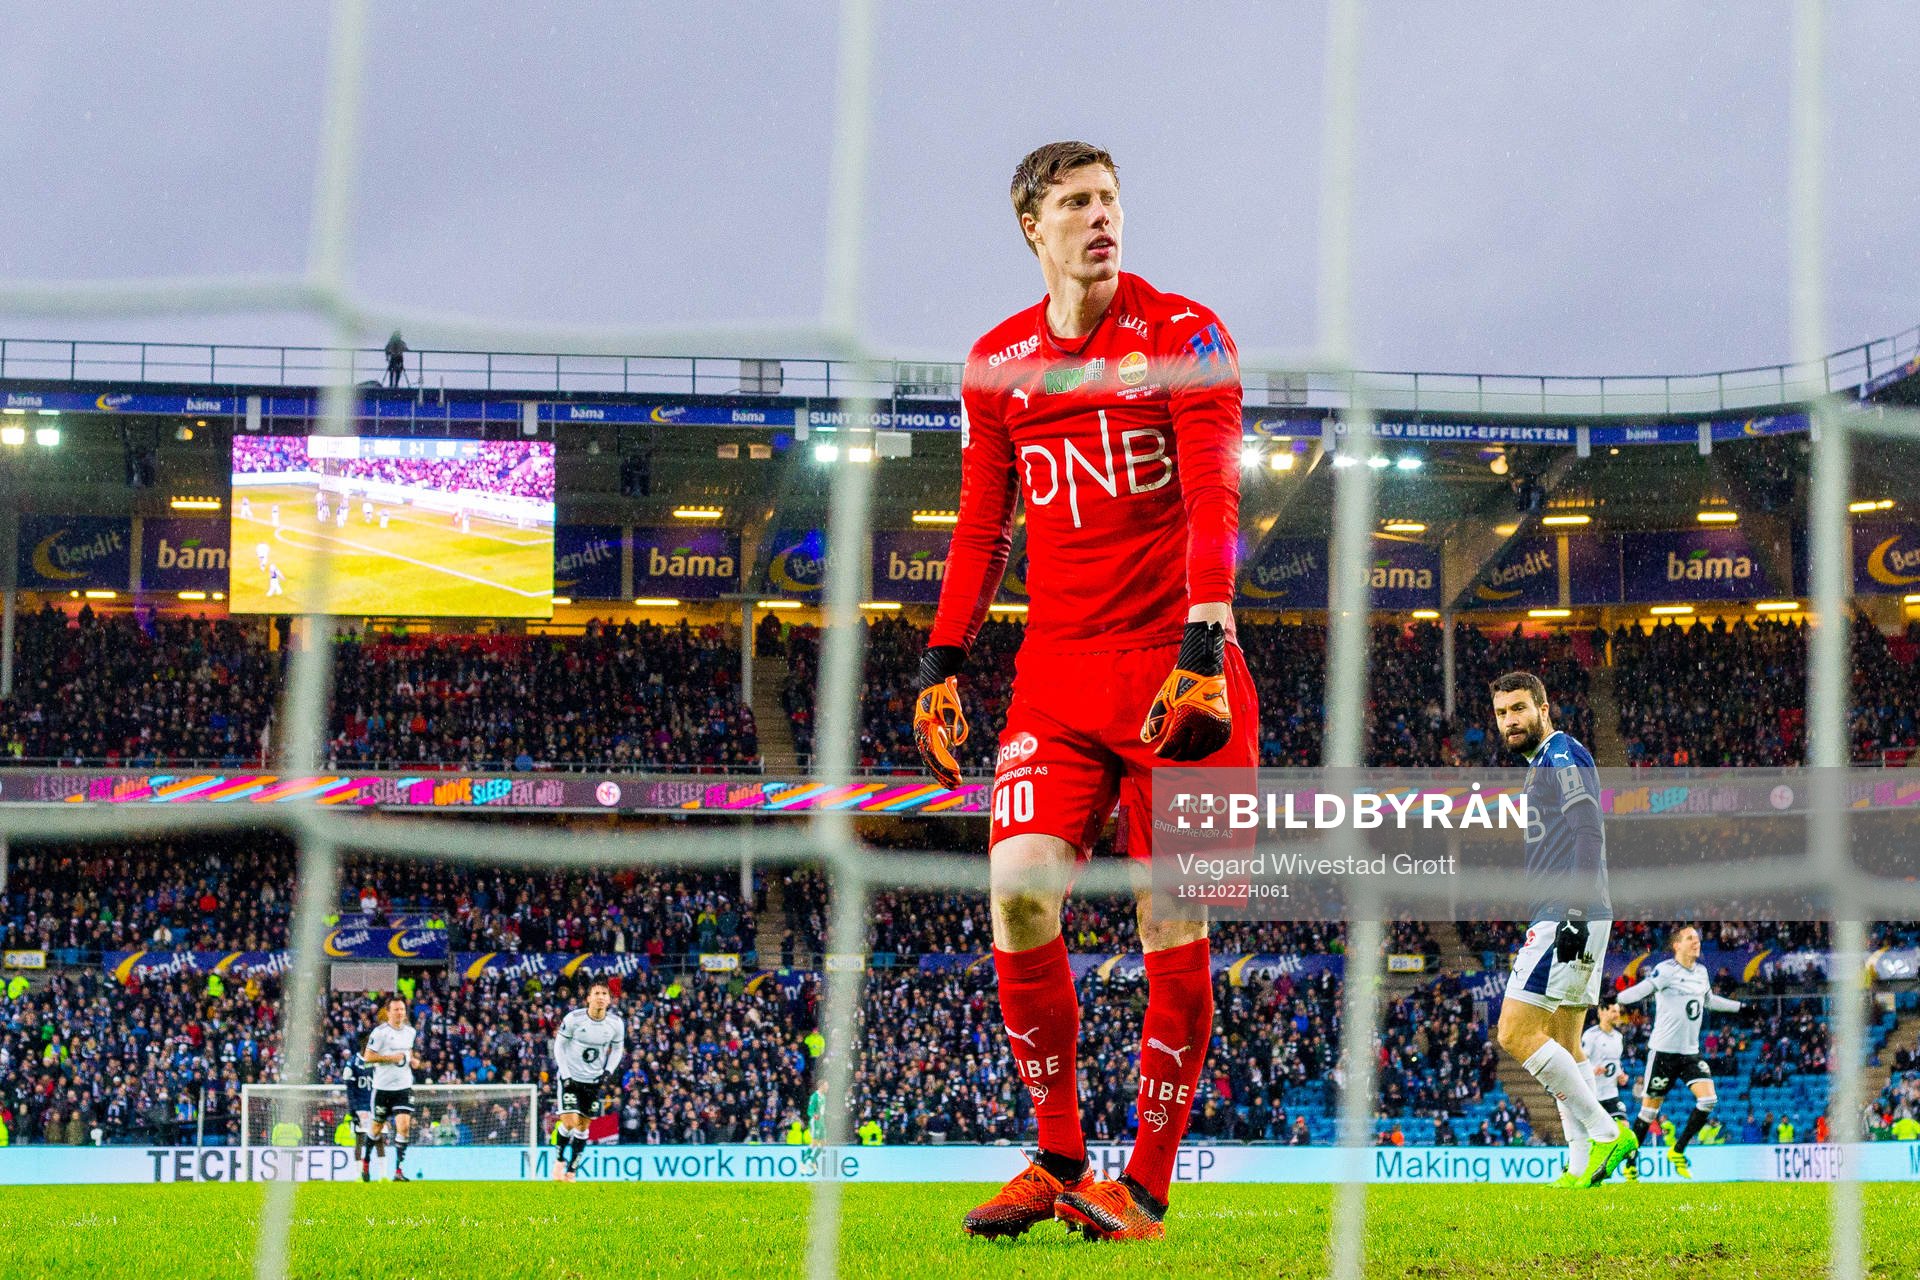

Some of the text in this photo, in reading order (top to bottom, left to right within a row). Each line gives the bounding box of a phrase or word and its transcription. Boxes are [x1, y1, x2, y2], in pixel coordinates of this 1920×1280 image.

[186, 398, 221, 411] bama
[570, 406, 604, 419] bama
[732, 410, 765, 423] bama
[1406, 424, 1569, 441] BENDIT-EFFEKTEN
[1626, 427, 1658, 440] bama
[1020, 409, 1173, 528] DNB
[58, 534, 123, 565] Bendit
[158, 538, 230, 569] bam
[649, 547, 734, 578] bama
[888, 552, 947, 581] bam
[1257, 551, 1318, 584] Bendit
[1668, 551, 1751, 582] bama
[1034, 766, 1048, 775] AS
[473, 778, 512, 806] SLEEP
[994, 780, 1035, 828] 40
[1154, 819, 1233, 839] ENTREPRENØR AS
[1139, 1074, 1190, 1105] TIBE
[147, 1150, 349, 1181] TECHSTEP
[520, 1150, 642, 1181] Mking
[653, 1149, 735, 1177] work
[1376, 1151, 1489, 1181] Making
[1775, 1147, 1845, 1179] TECHSTEP
